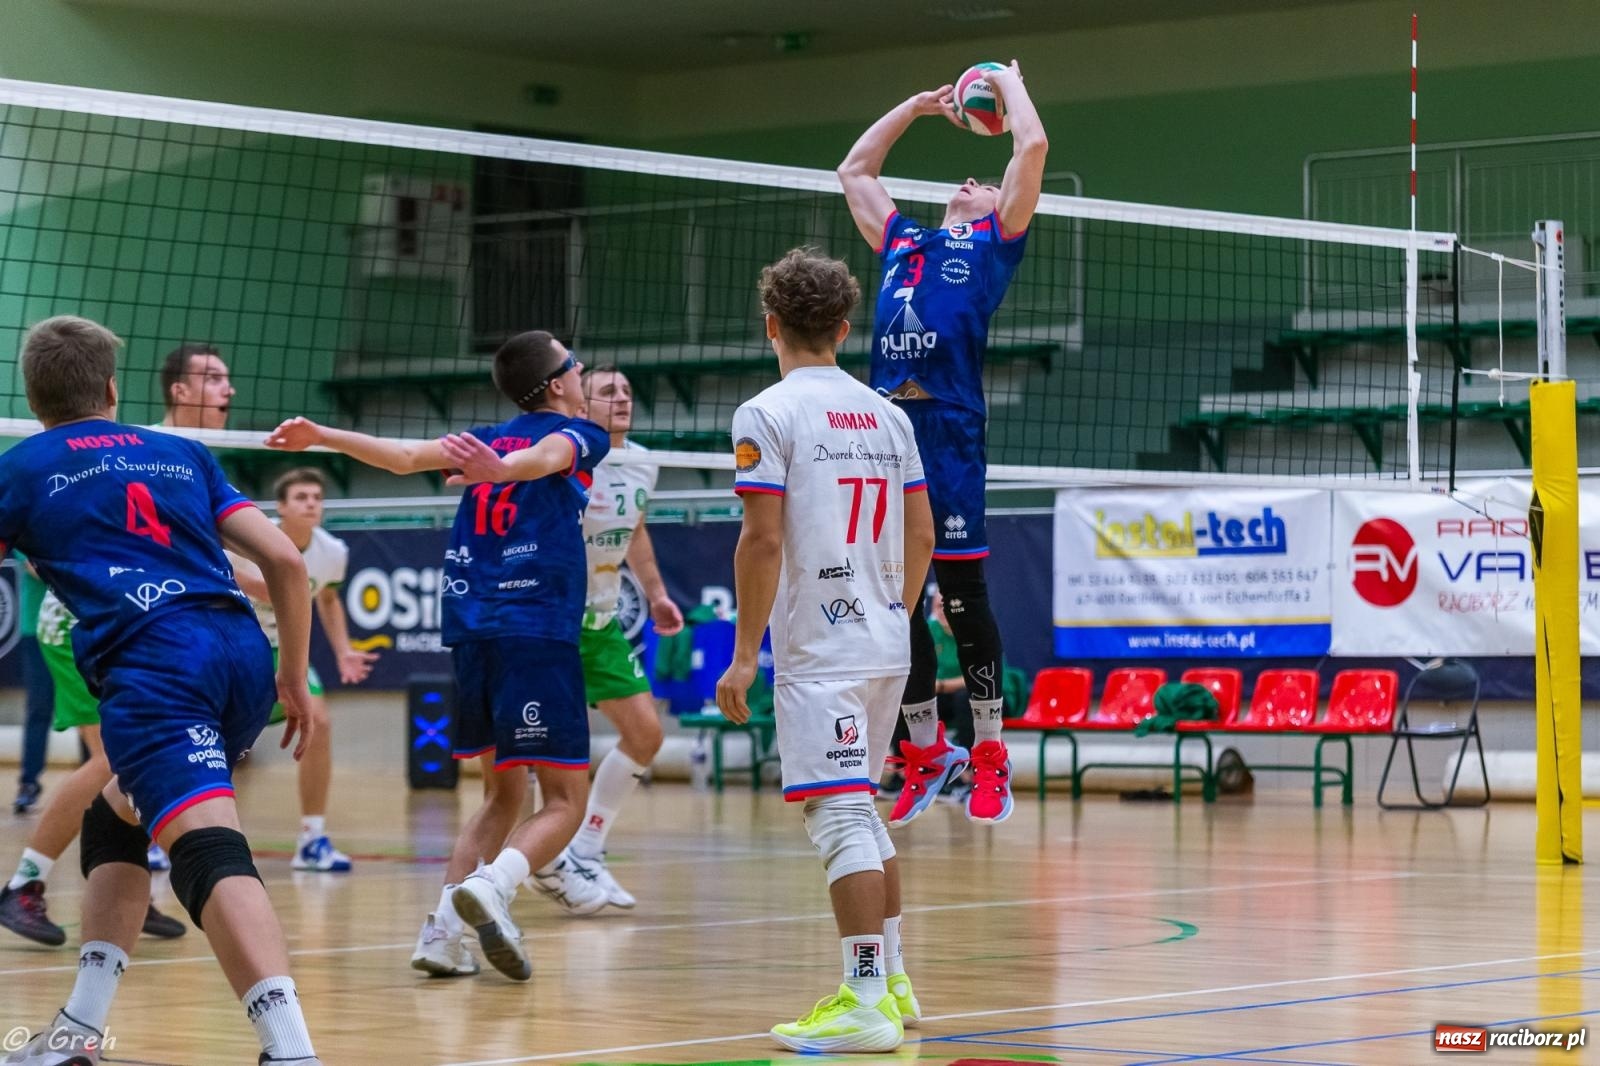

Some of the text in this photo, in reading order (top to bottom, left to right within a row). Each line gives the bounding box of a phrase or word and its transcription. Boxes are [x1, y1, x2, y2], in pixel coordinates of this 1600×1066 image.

[903, 254, 925, 287] 3
[885, 350, 929, 360] OLSK
[826, 411, 878, 430] ROMAN
[66, 434, 144, 450] NOSYK
[813, 441, 854, 461] Dworek
[47, 455, 193, 497] Dworek Szwajcaria
[126, 482, 172, 548] 4
[471, 482, 518, 536] 16
[616, 494, 626, 516] 2
[838, 478, 888, 543] 77
[1437, 519, 1530, 538] RAD
[826, 747, 867, 760] epaka.pl
[858, 946, 876, 977] MKS
